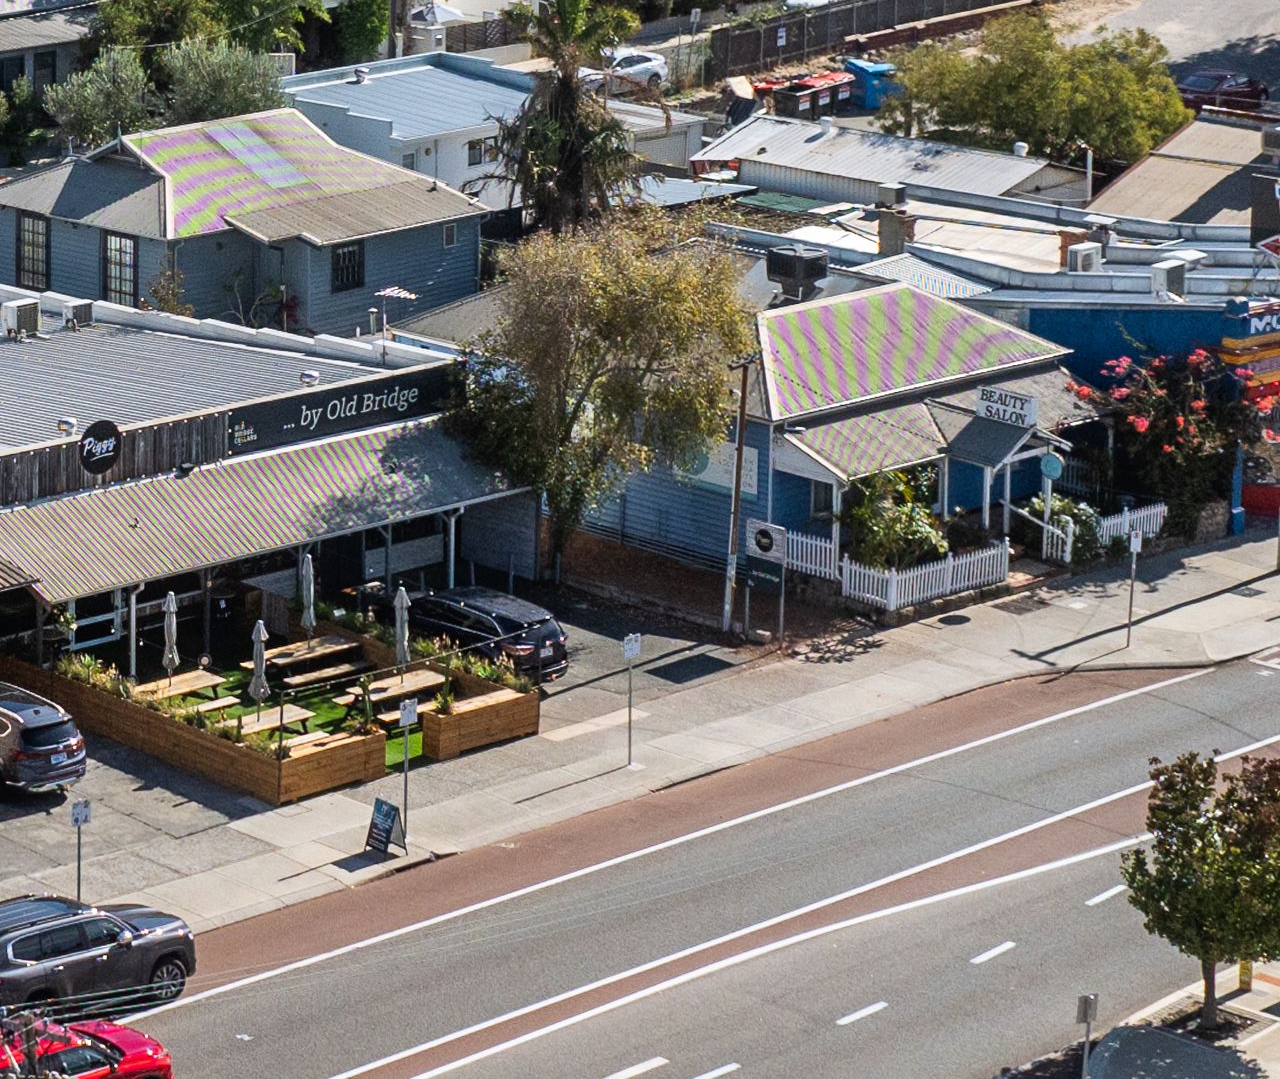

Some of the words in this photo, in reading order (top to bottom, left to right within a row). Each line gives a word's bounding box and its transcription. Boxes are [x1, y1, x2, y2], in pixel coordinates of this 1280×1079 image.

[300, 405, 323, 430] by
[326, 395, 358, 420] Old
[360, 386, 420, 414] Bridge
[980, 388, 1028, 411] BEAUTY
[984, 404, 1028, 426] SALON
